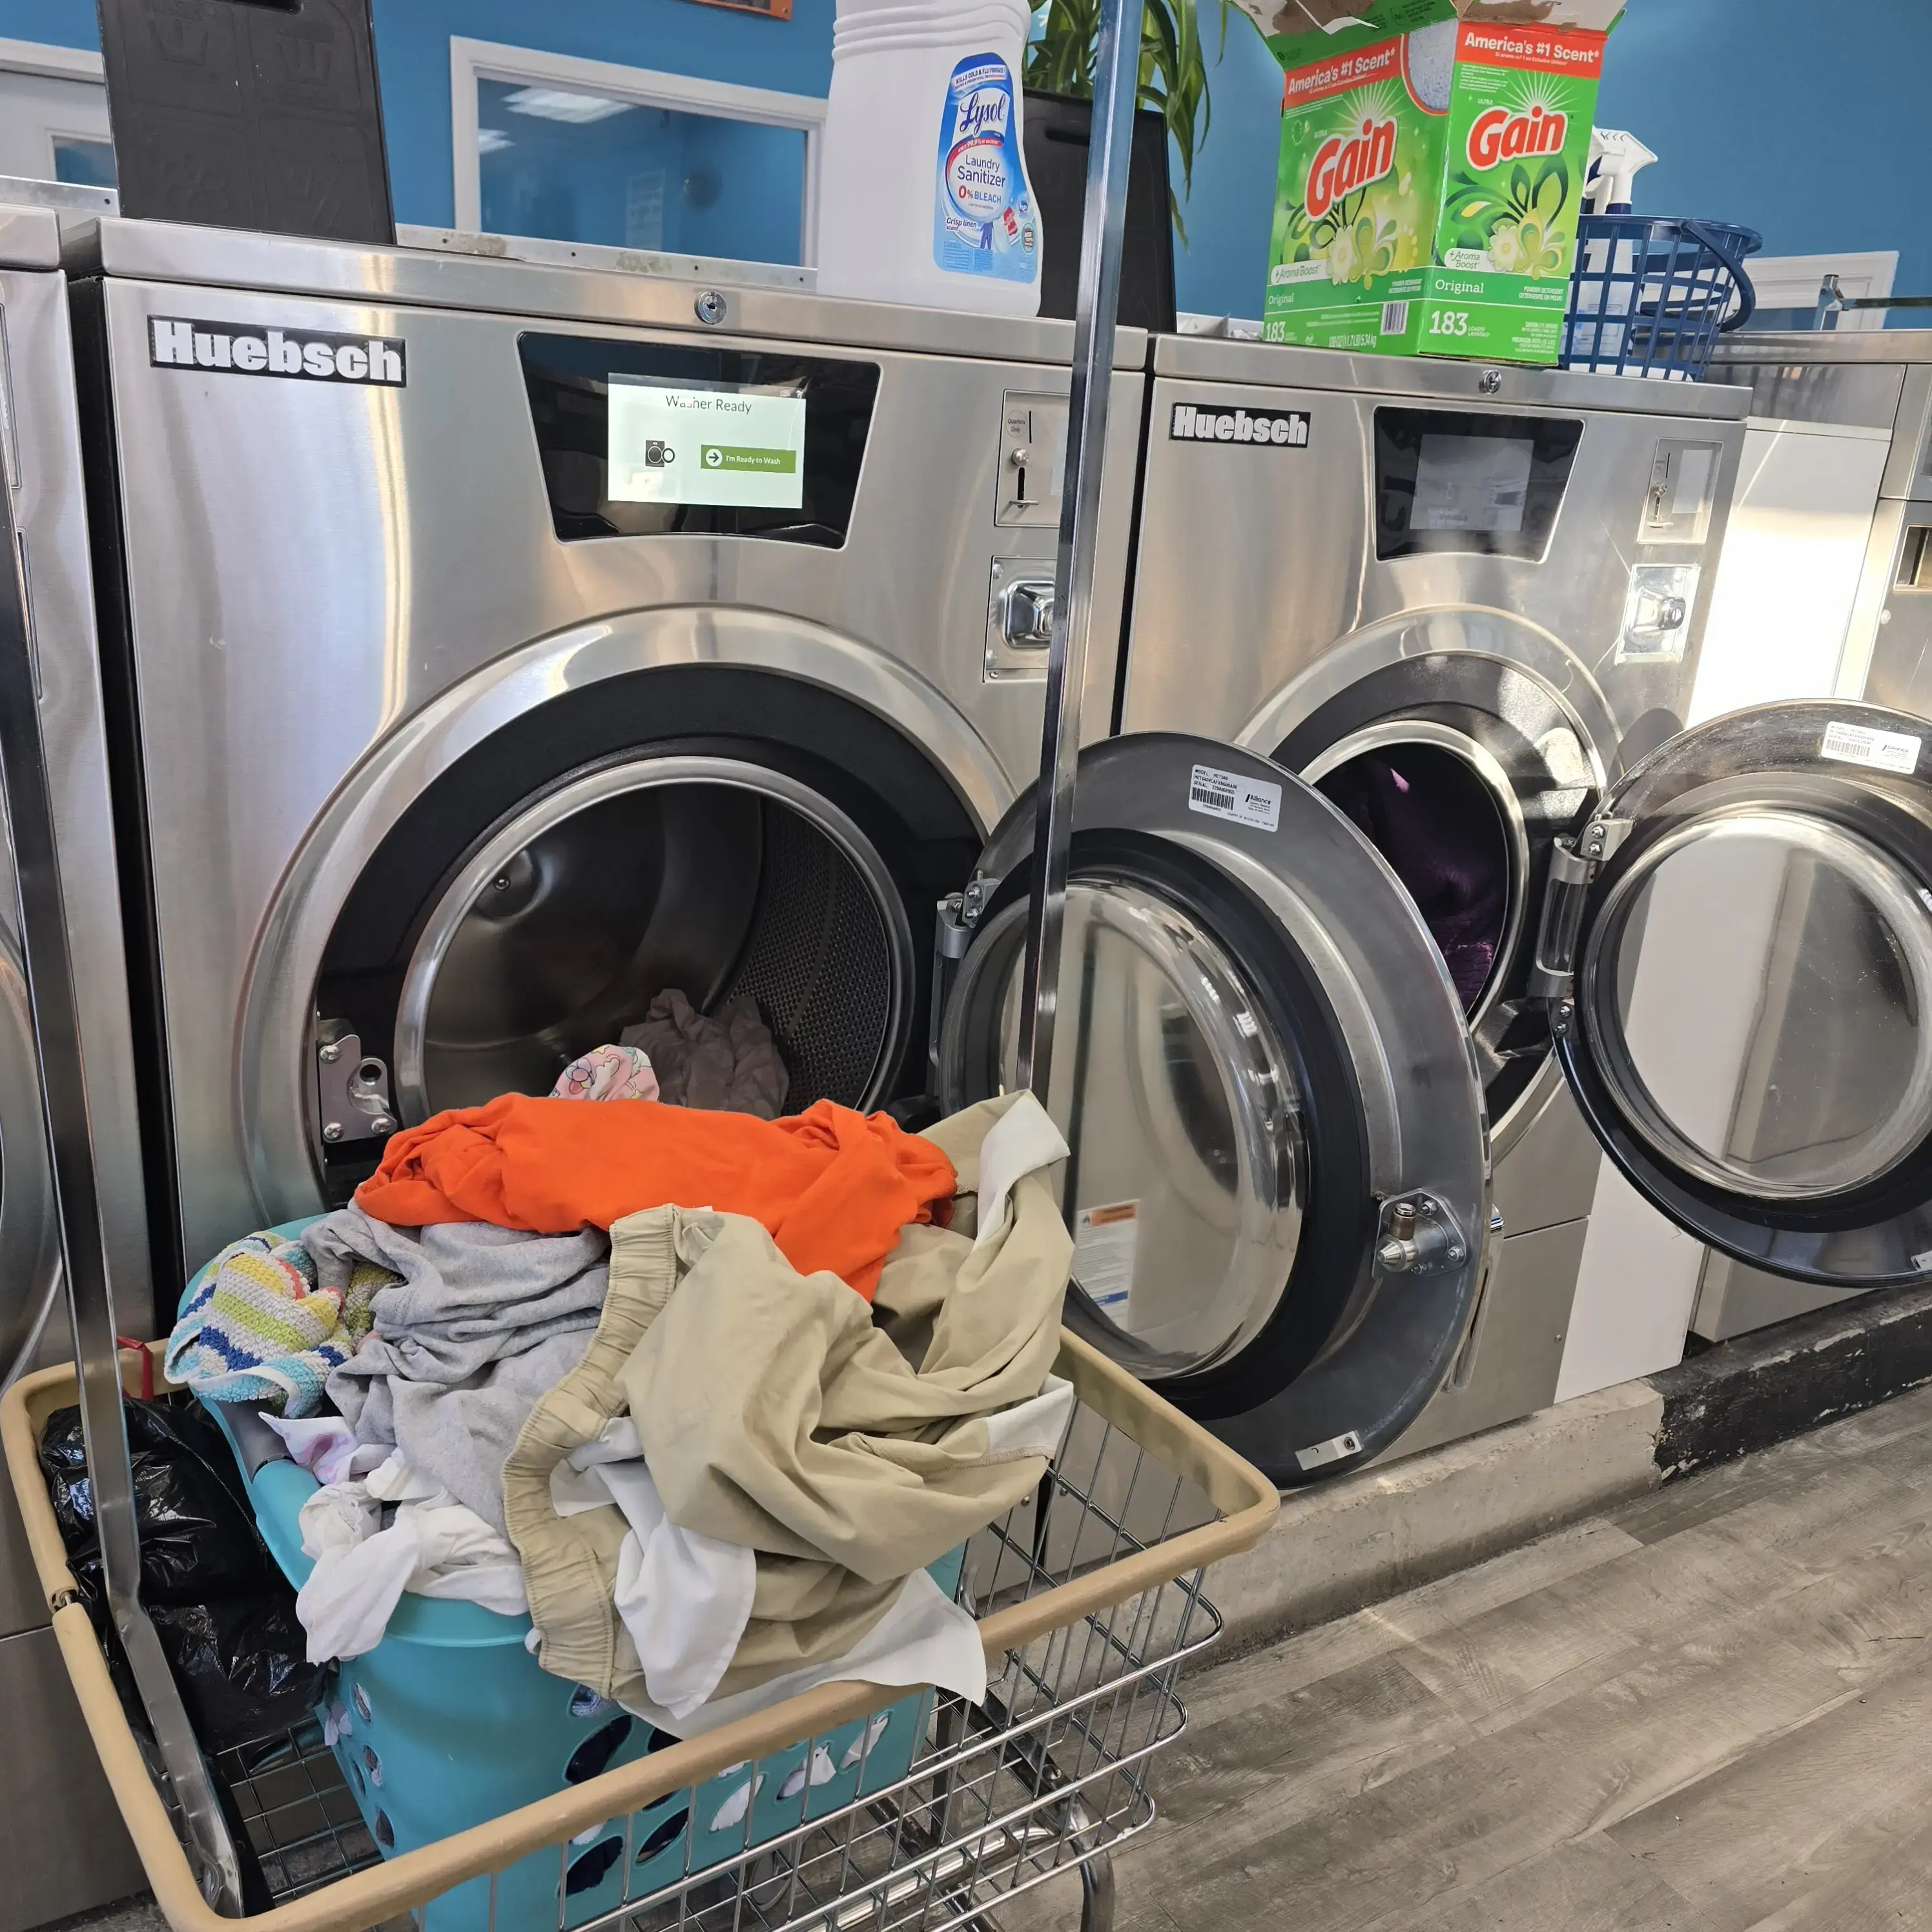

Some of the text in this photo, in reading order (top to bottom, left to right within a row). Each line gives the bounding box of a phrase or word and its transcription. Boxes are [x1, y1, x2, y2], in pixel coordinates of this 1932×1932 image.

[1465, 32, 1534, 55] America's
[1536, 42, 1550, 57] #1
[956, 74, 968, 84] KILLS
[1288, 66, 1339, 94] America's
[1340, 60, 1353, 76] #1
[959, 92, 1007, 136] Lysol
[1468, 105, 1566, 167] Gain
[965, 154, 1000, 172] Laundry
[1306, 118, 1395, 217] Gain
[958, 165, 1006, 187] Sanitizer
[958, 185, 1002, 204] 0% BLEACH
[946, 217, 977, 228] Crisp linen
[1435, 279, 1485, 294] Original
[1268, 293, 1295, 307] Original
[1265, 321, 1286, 342] 183
[1429, 310, 1469, 336] 183
[152, 320, 402, 382] Huebsch
[715, 398, 752, 415] Ready
[1173, 405, 1308, 445] Huebsch
[736, 456, 755, 465] Ready
[1250, 794, 1271, 805] Alliance
